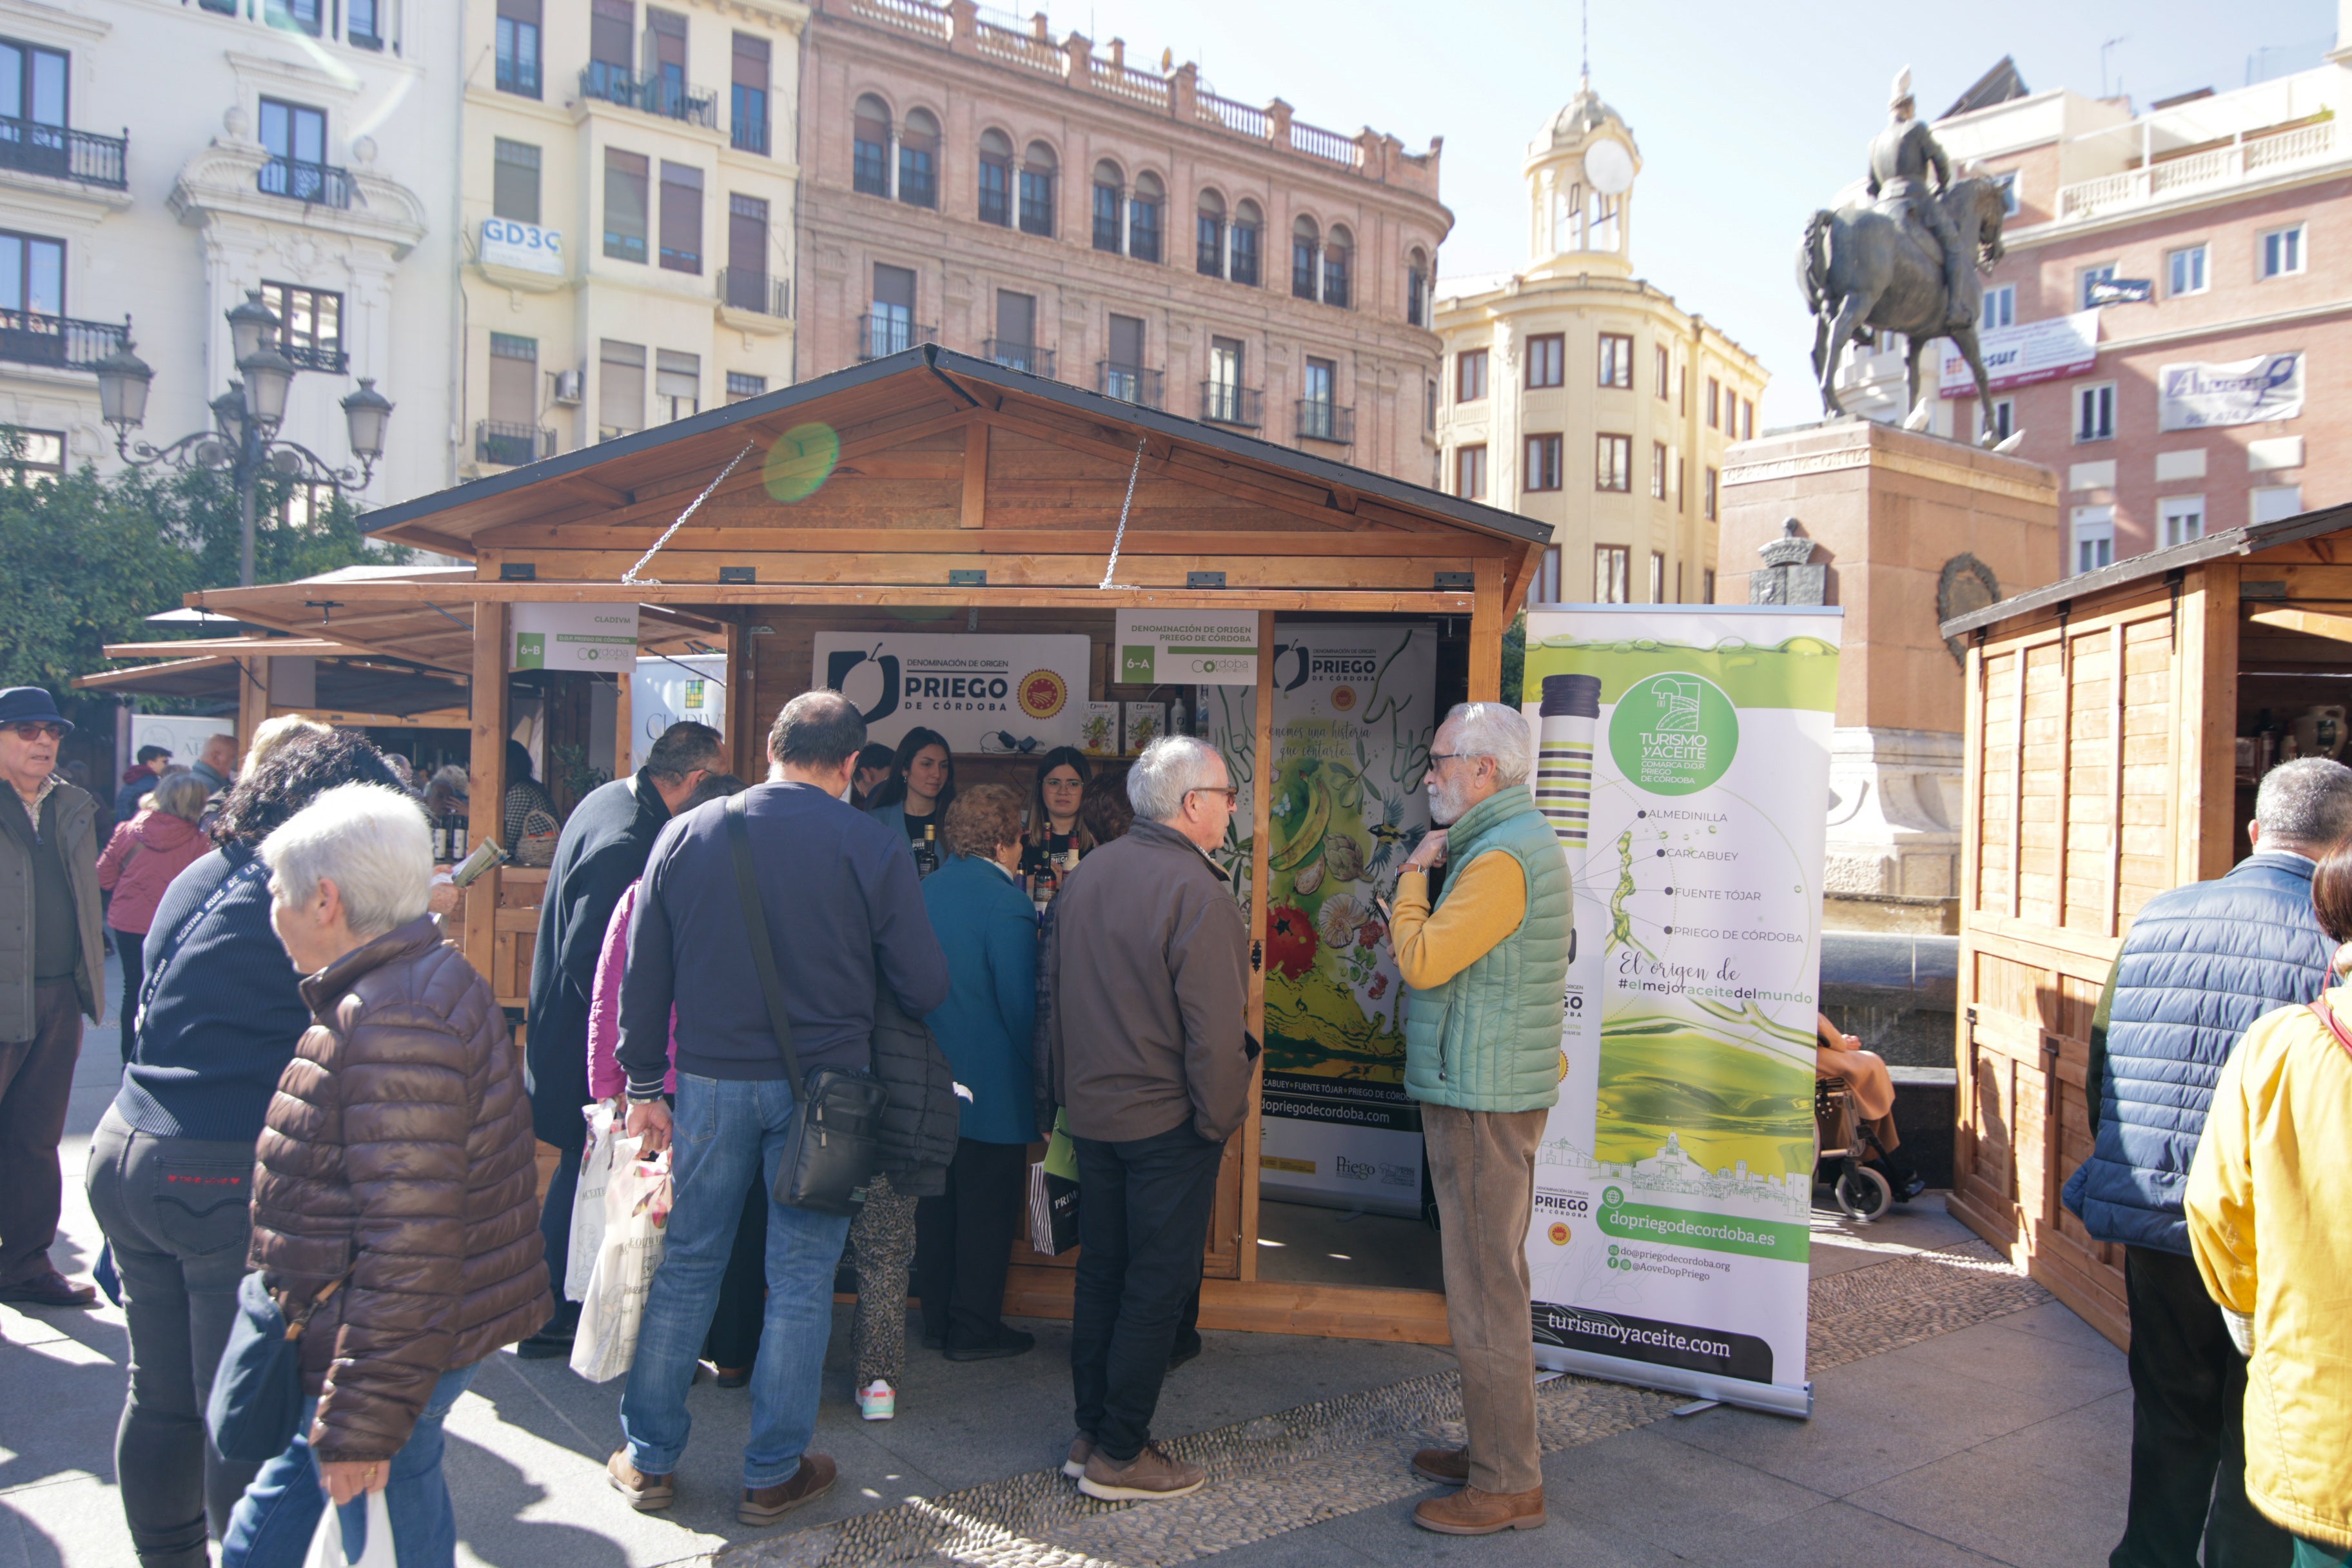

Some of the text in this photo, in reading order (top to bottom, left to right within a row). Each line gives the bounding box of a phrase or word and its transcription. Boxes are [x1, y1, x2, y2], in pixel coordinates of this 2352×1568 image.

[1132, 624, 1201, 632] DENOMINACIÓN
[1208, 633, 1251, 642] CÓRDOBA
[520, 645, 540, 655] 6-B
[577, 647, 629, 660] Córdoba
[907, 658, 966, 667] DENOMINACIÓN
[1126, 658, 1150, 669] 6-A
[1191, 659, 1249, 673] Córdoba
[1312, 660, 1376, 673] PRIEGO
[905, 678, 1008, 698] PRIEGO
[933, 701, 1007, 711] CÓRDOBA
[1271, 720, 1371, 740] enemos una historia
[1639, 732, 1707, 747] TURISMO
[1280, 746, 1298, 763] que
[1653, 775, 1695, 784] CÓRDOBA
[1648, 810, 1727, 822] ALMEDINILLA
[1667, 848, 1739, 861] CARCABUEY
[1676, 888, 1761, 901] FUENTE TÓJAR
[175, 911, 204, 945] AGATHA
[204, 888, 225, 910] RUIZ
[226, 874, 242, 888] DE
[244, 863, 260, 876] LA
[1674, 926, 1803, 943] PRIEGO DE CÓRDOBA
[1620, 951, 1741, 988] El origen de
[1618, 978, 1812, 1004] #elmejoraceitedelmundo
[1263, 1079, 1411, 1101] CABUEY FUENTE TÓJAR PRIEGO DE CÓRDO
[1055, 1190, 1078, 1210] PRIM
[1535, 1195, 1588, 1211] PRIEGO
[1549, 1209, 1587, 1219] CÓRDOBA
[1610, 1210, 1775, 1246] dopriegodecordoba.es
[1621, 1247, 1730, 1272] do@priegodecordoba.org
[1632, 1262, 1710, 1281] @AoveDopPriego
[1547, 1312, 1730, 1358] turismoyaceite.com
